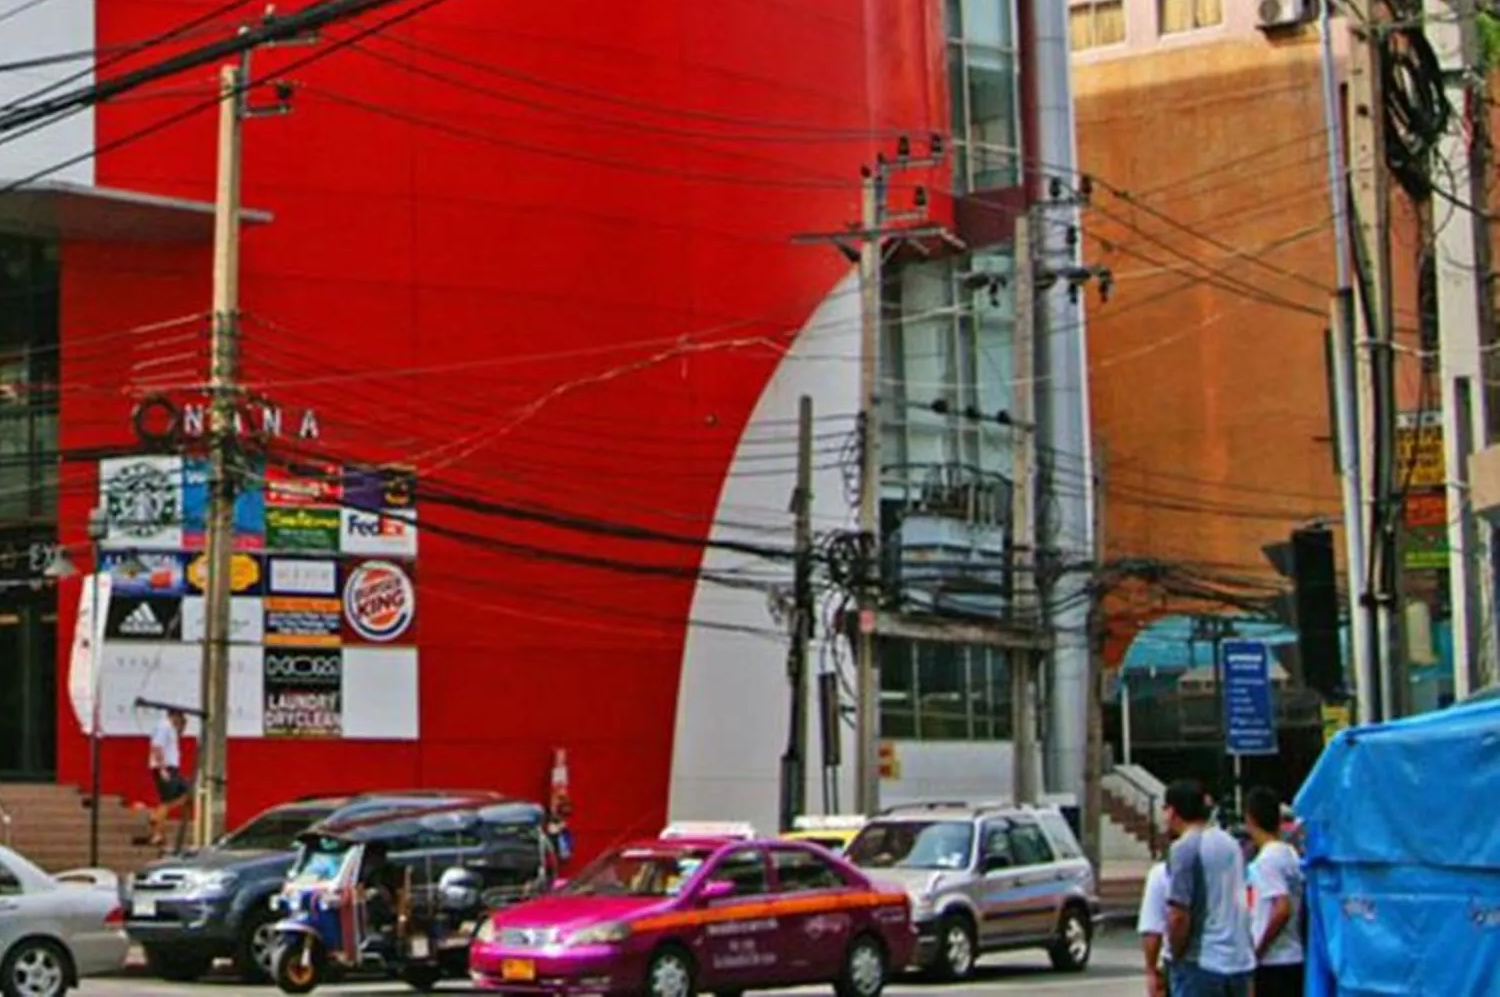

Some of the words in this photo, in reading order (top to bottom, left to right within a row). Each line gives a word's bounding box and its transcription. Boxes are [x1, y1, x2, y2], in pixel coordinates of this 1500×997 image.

[347, 515, 405, 537] FedEx
[357, 589, 405, 616] KING
[268, 693, 338, 711] LAUNDRY
